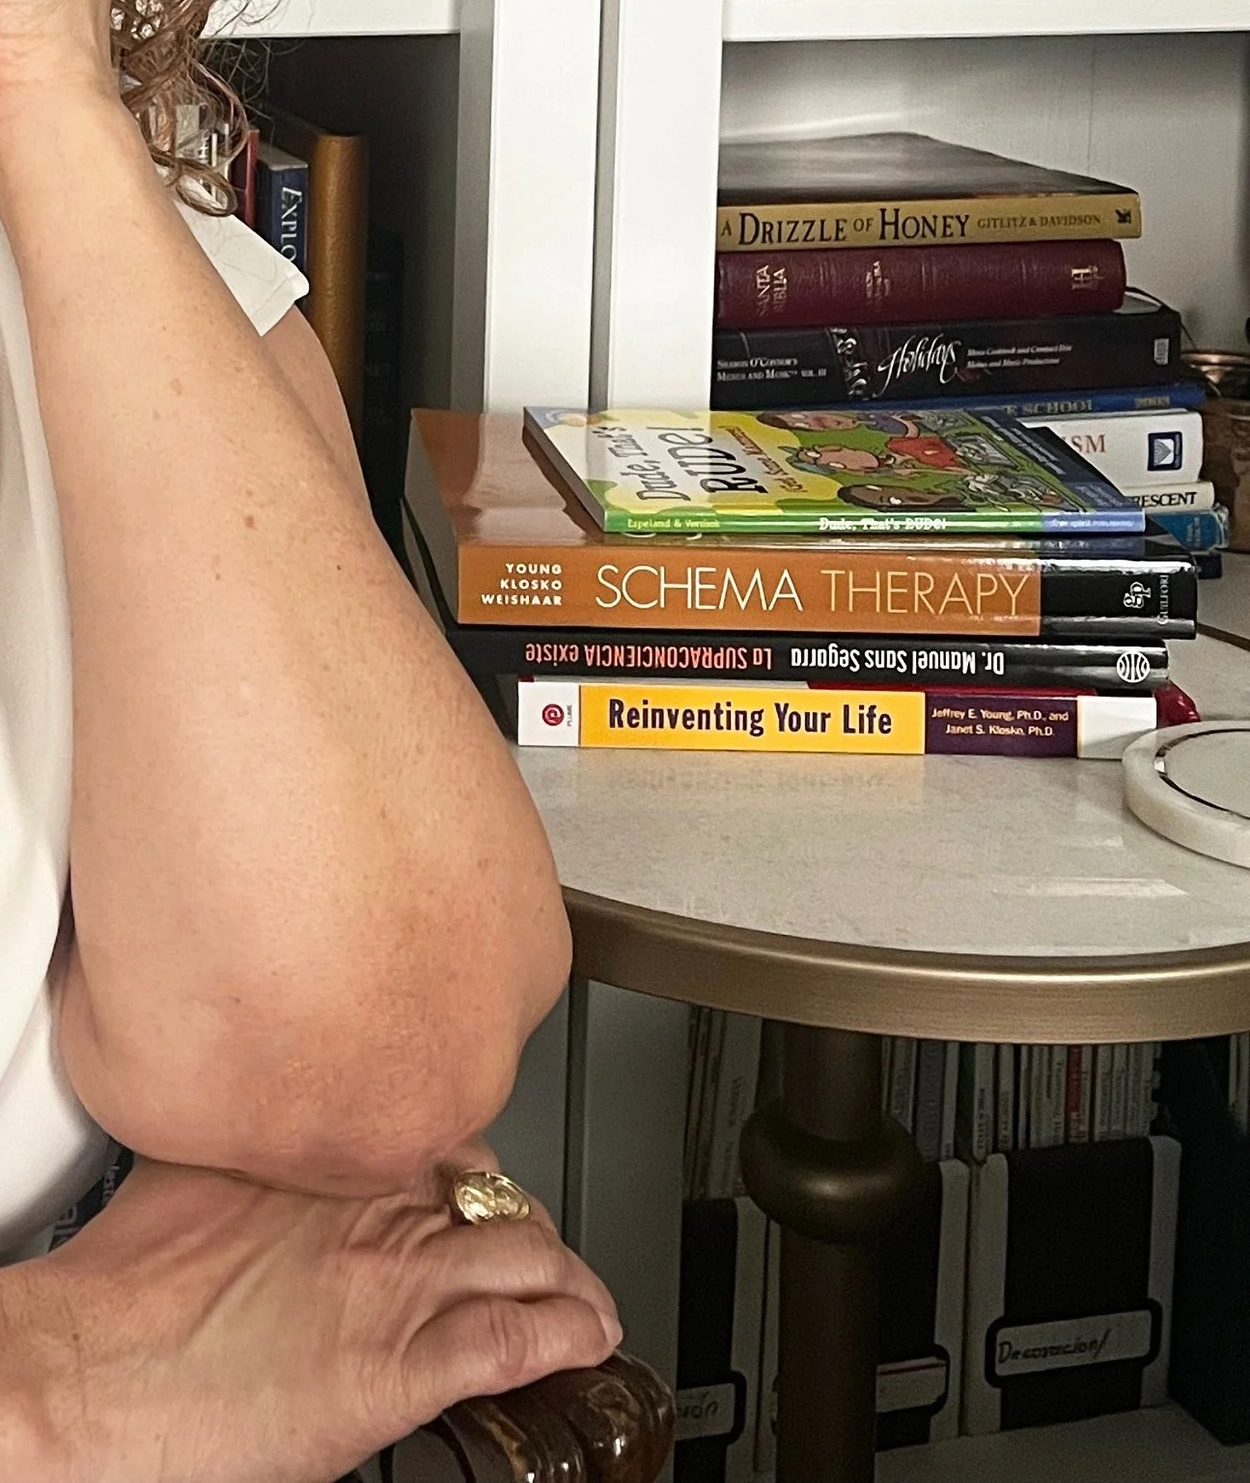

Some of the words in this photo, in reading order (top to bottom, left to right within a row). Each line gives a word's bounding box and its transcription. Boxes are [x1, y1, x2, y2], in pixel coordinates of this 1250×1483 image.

[871, 332, 965, 399] Holidays
[505, 562, 563, 575] YOUNG
[499, 578, 563, 591] KLOSKO
[594, 564, 804, 612] SCHEMA
[820, 568, 1030, 617] THERAPY
[479, 593, 563, 606] WEISHAAR
[523, 642, 579, 666] existe
[582, 643, 748, 669] SUPRACONCIENCIA
[752, 648, 773, 670] La
[790, 643, 860, 672] Segarra
[864, 649, 907, 671] Sans
[911, 649, 976, 675] Manuel
[980, 651, 1005, 676] Dr.
[608, 698, 765, 738] Reinventing
[774, 701, 832, 734] Your
[841, 704, 892, 735] Life
[931, 708, 966, 720] Jeffrey
[1048, 711, 1069, 722] and
[945, 724, 973, 735] Janet
